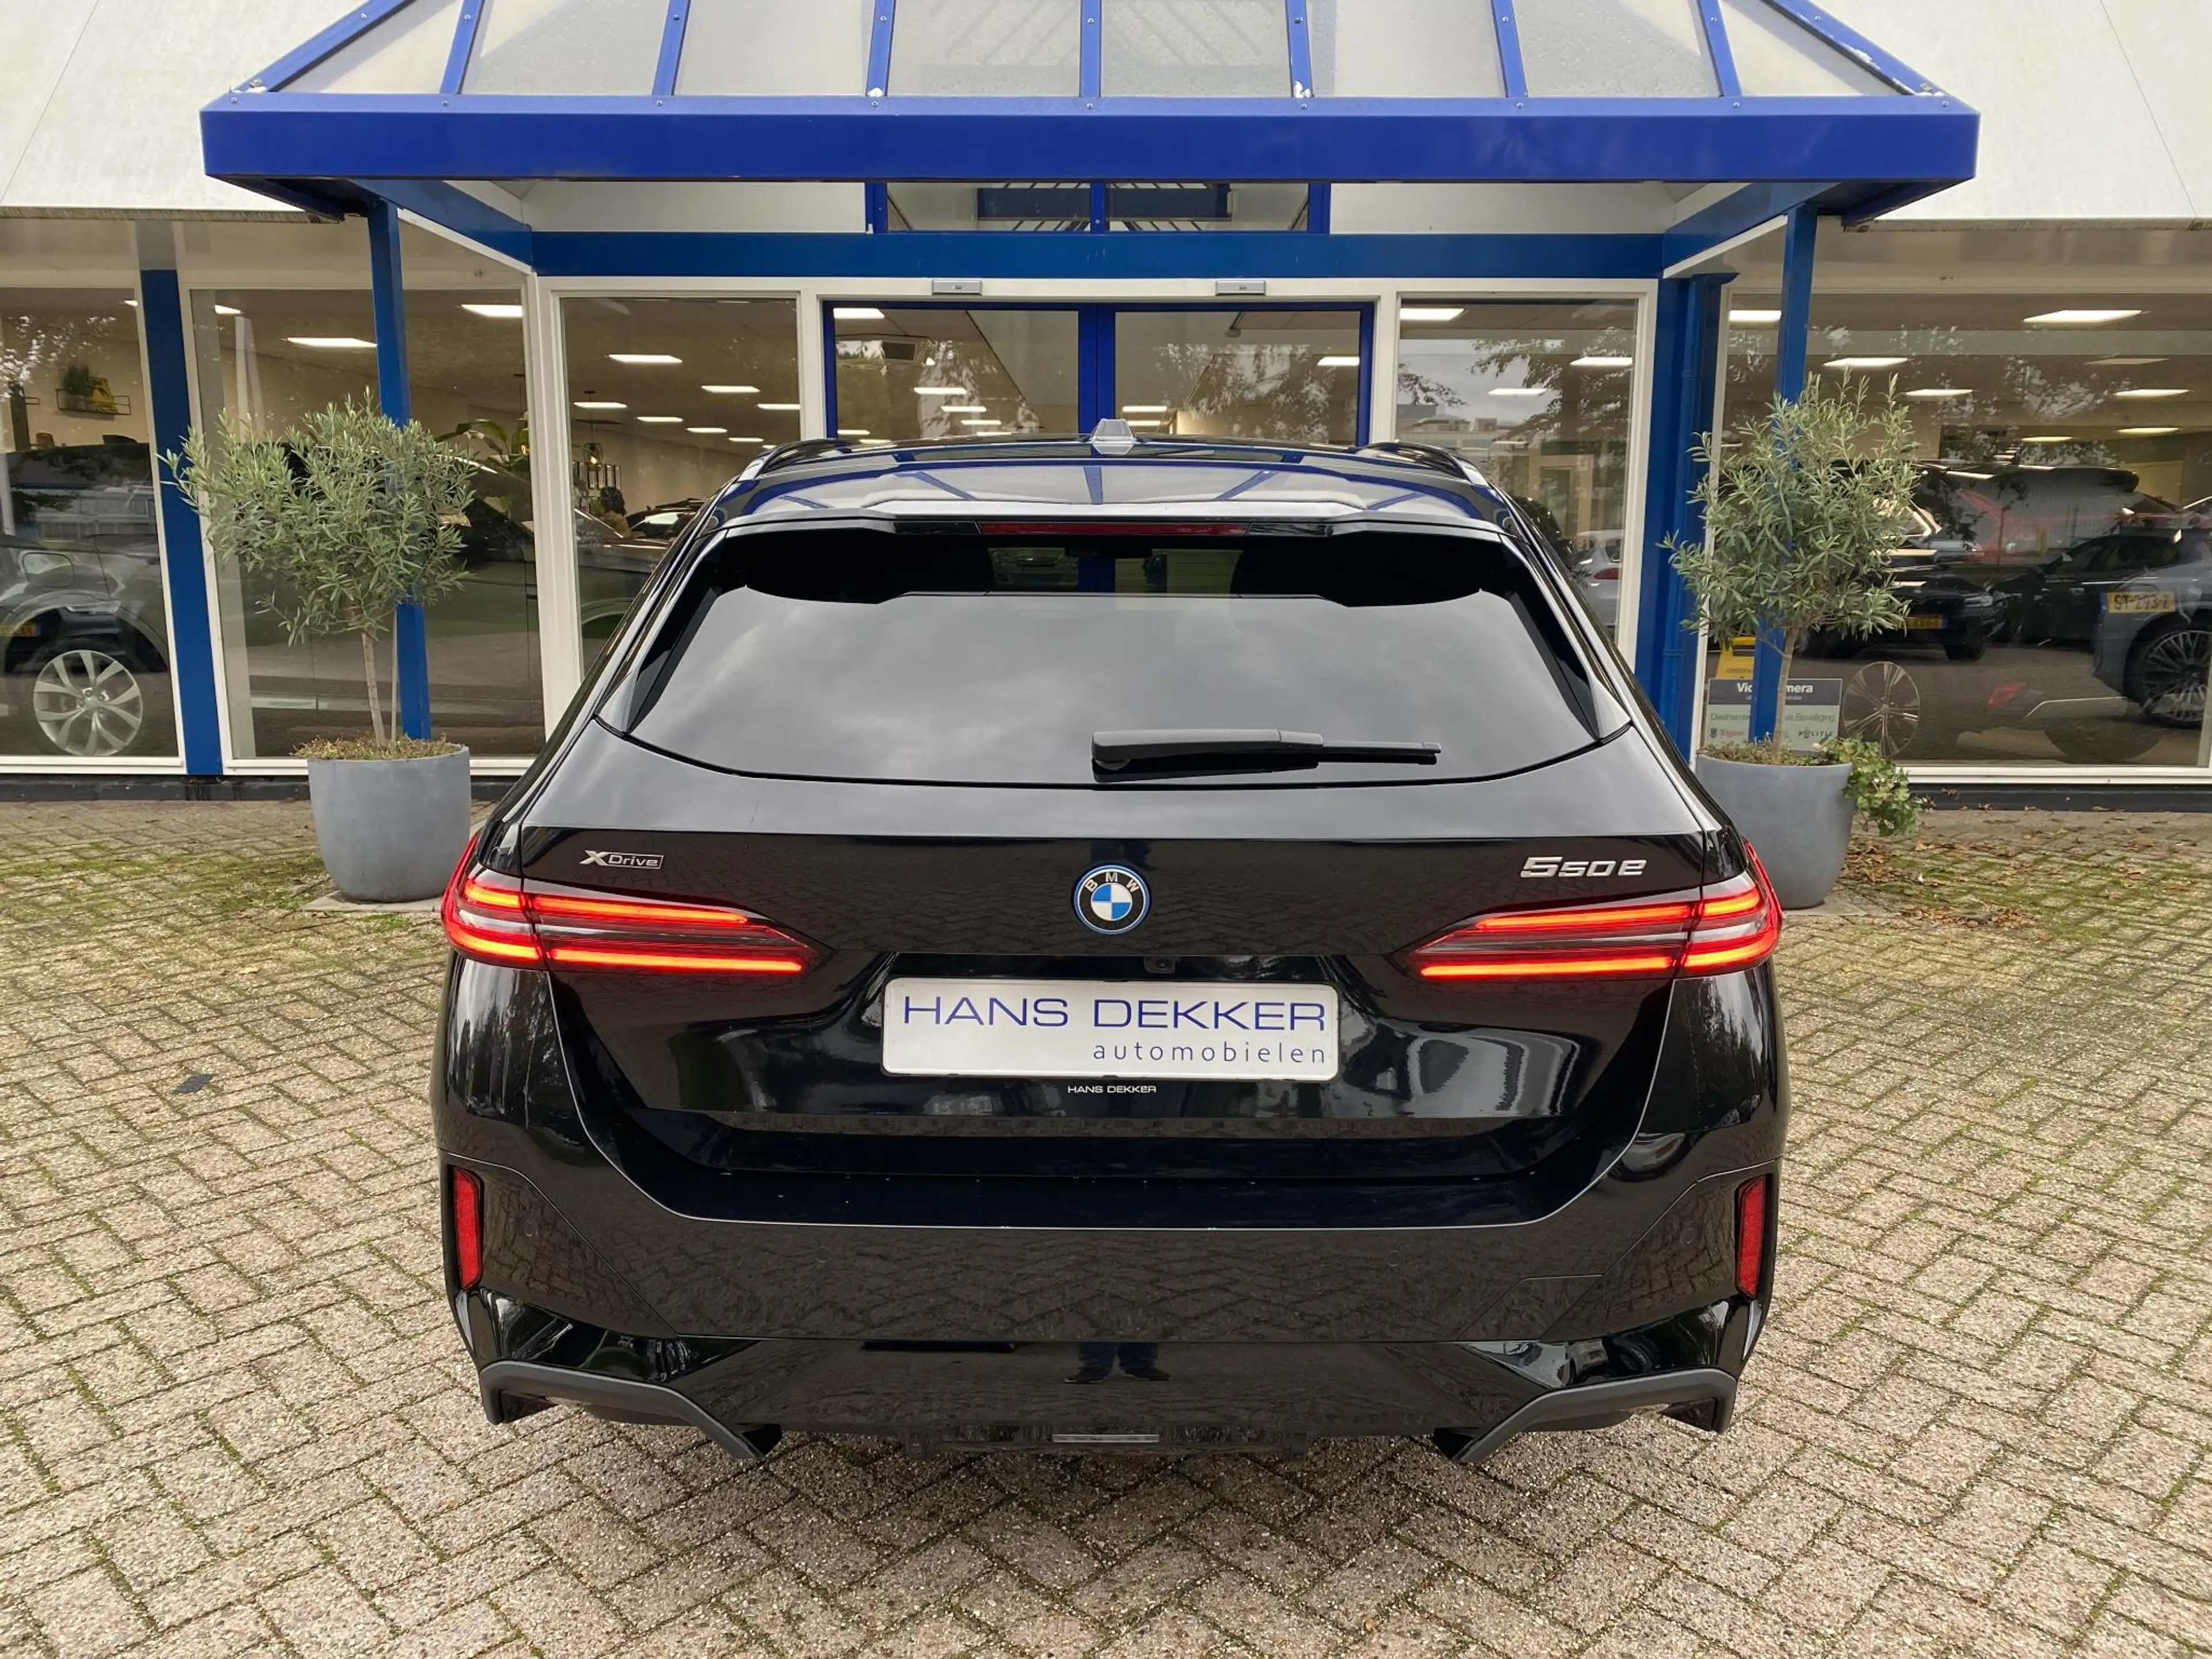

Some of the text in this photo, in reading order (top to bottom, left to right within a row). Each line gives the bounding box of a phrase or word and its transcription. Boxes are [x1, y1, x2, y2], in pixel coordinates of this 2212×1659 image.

[1085, 872, 1139, 893] BMW
[904, 995, 1325, 1031] HANS DEKKER
[1093, 1041, 1325, 1064] automobielen
[1067, 1085, 1157, 1093] HANS DEKKER
